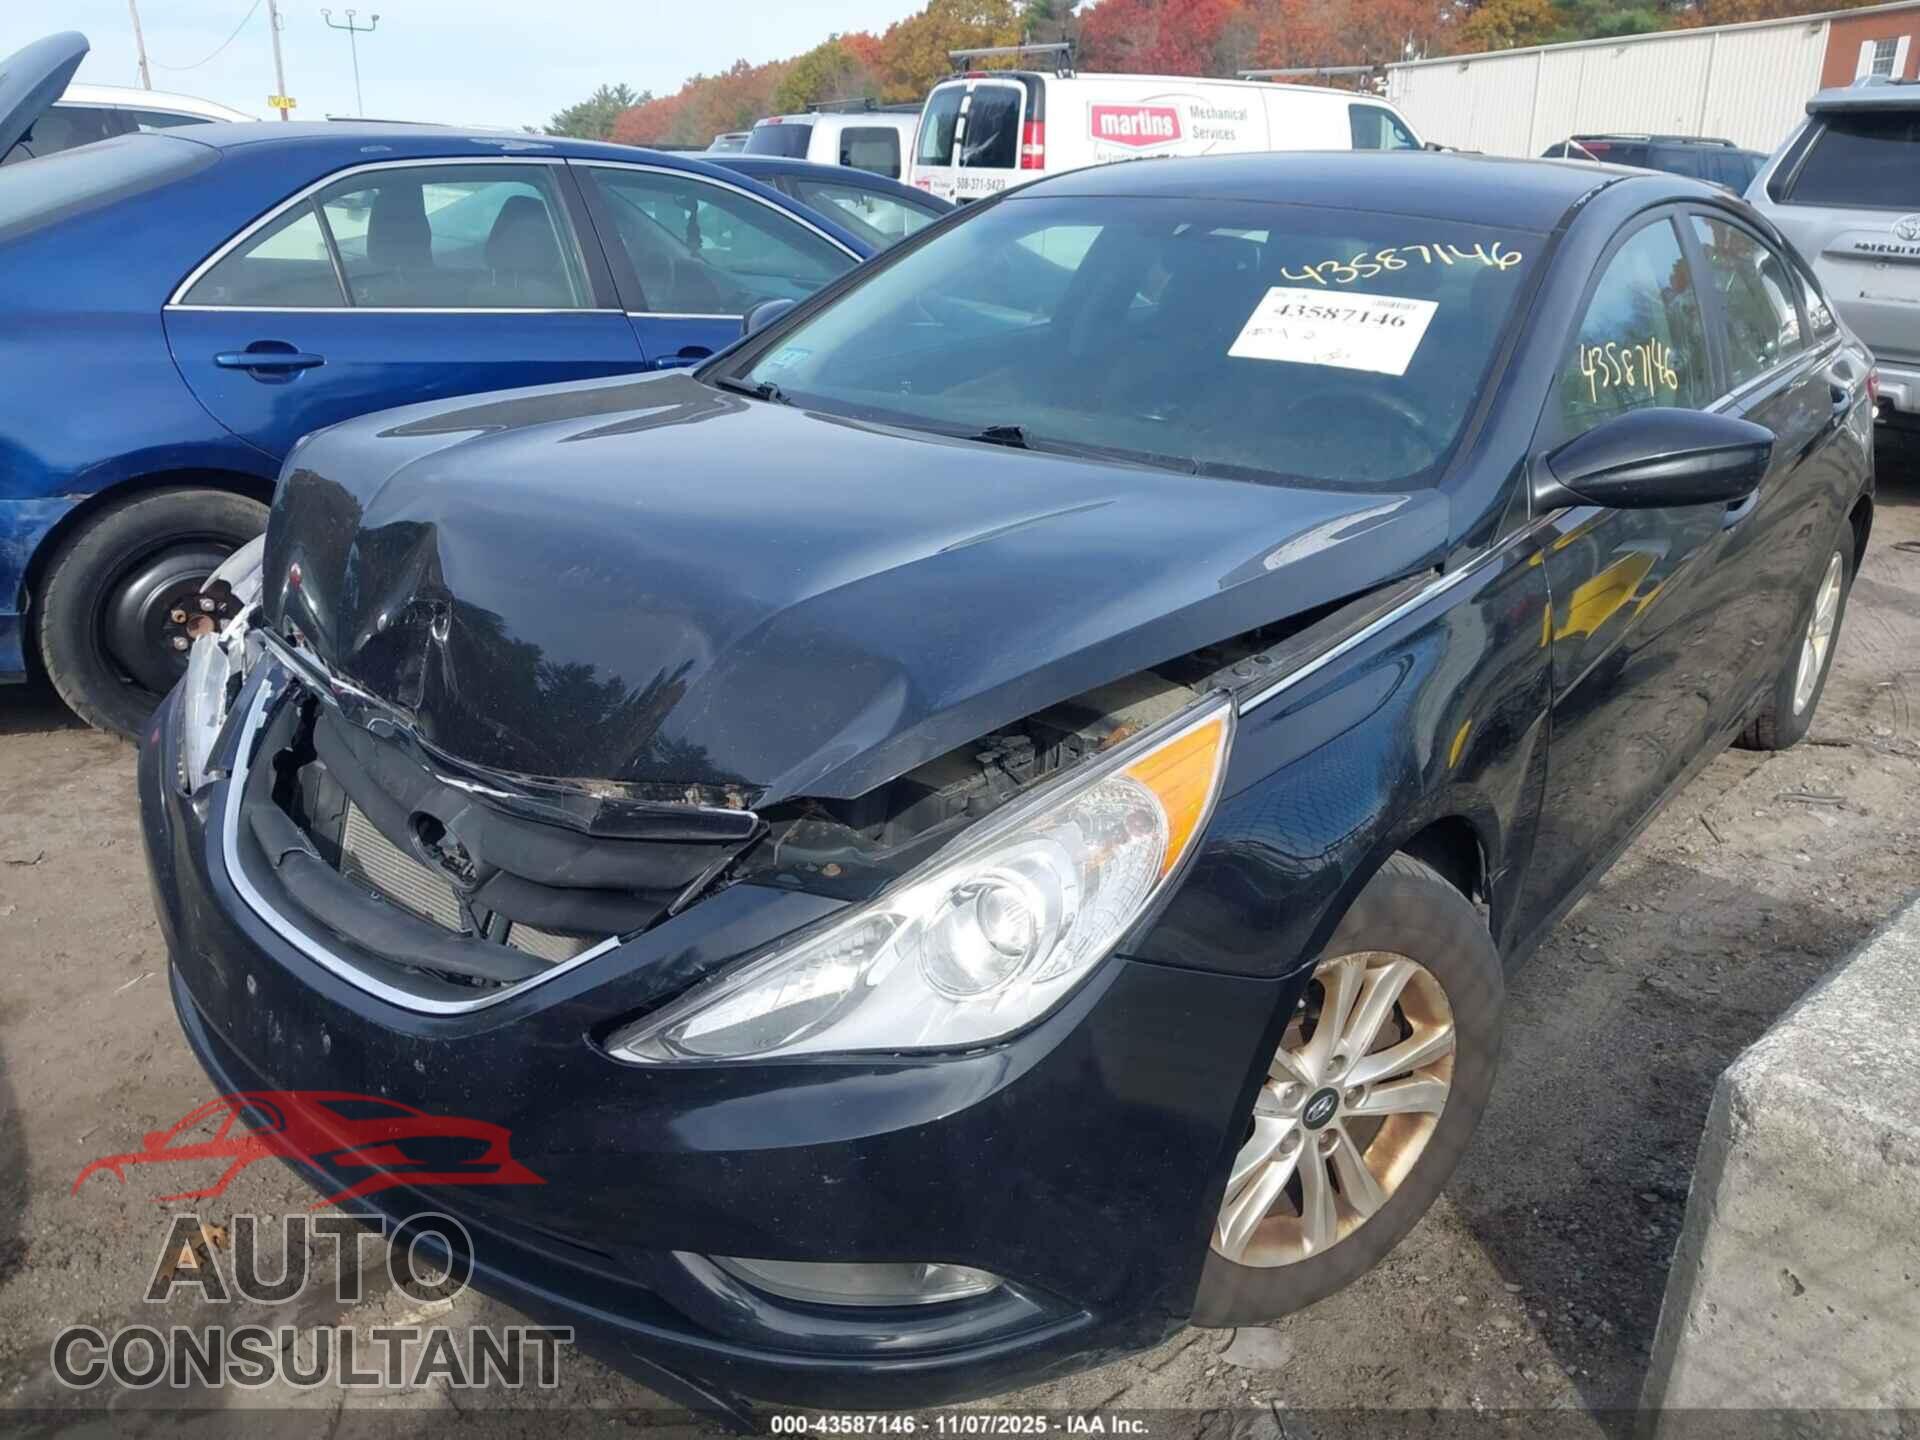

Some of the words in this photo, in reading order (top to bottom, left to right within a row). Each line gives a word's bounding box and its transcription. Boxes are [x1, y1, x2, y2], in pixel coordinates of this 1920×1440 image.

[1100, 109, 1174, 136] martins
[1189, 105, 1248, 121] Mechanical
[1192, 125, 1236, 141] Services
[1281, 242, 1522, 285] 43587146
[1273, 303, 1406, 328] 43587146
[1580, 337, 1678, 403] 43587146
